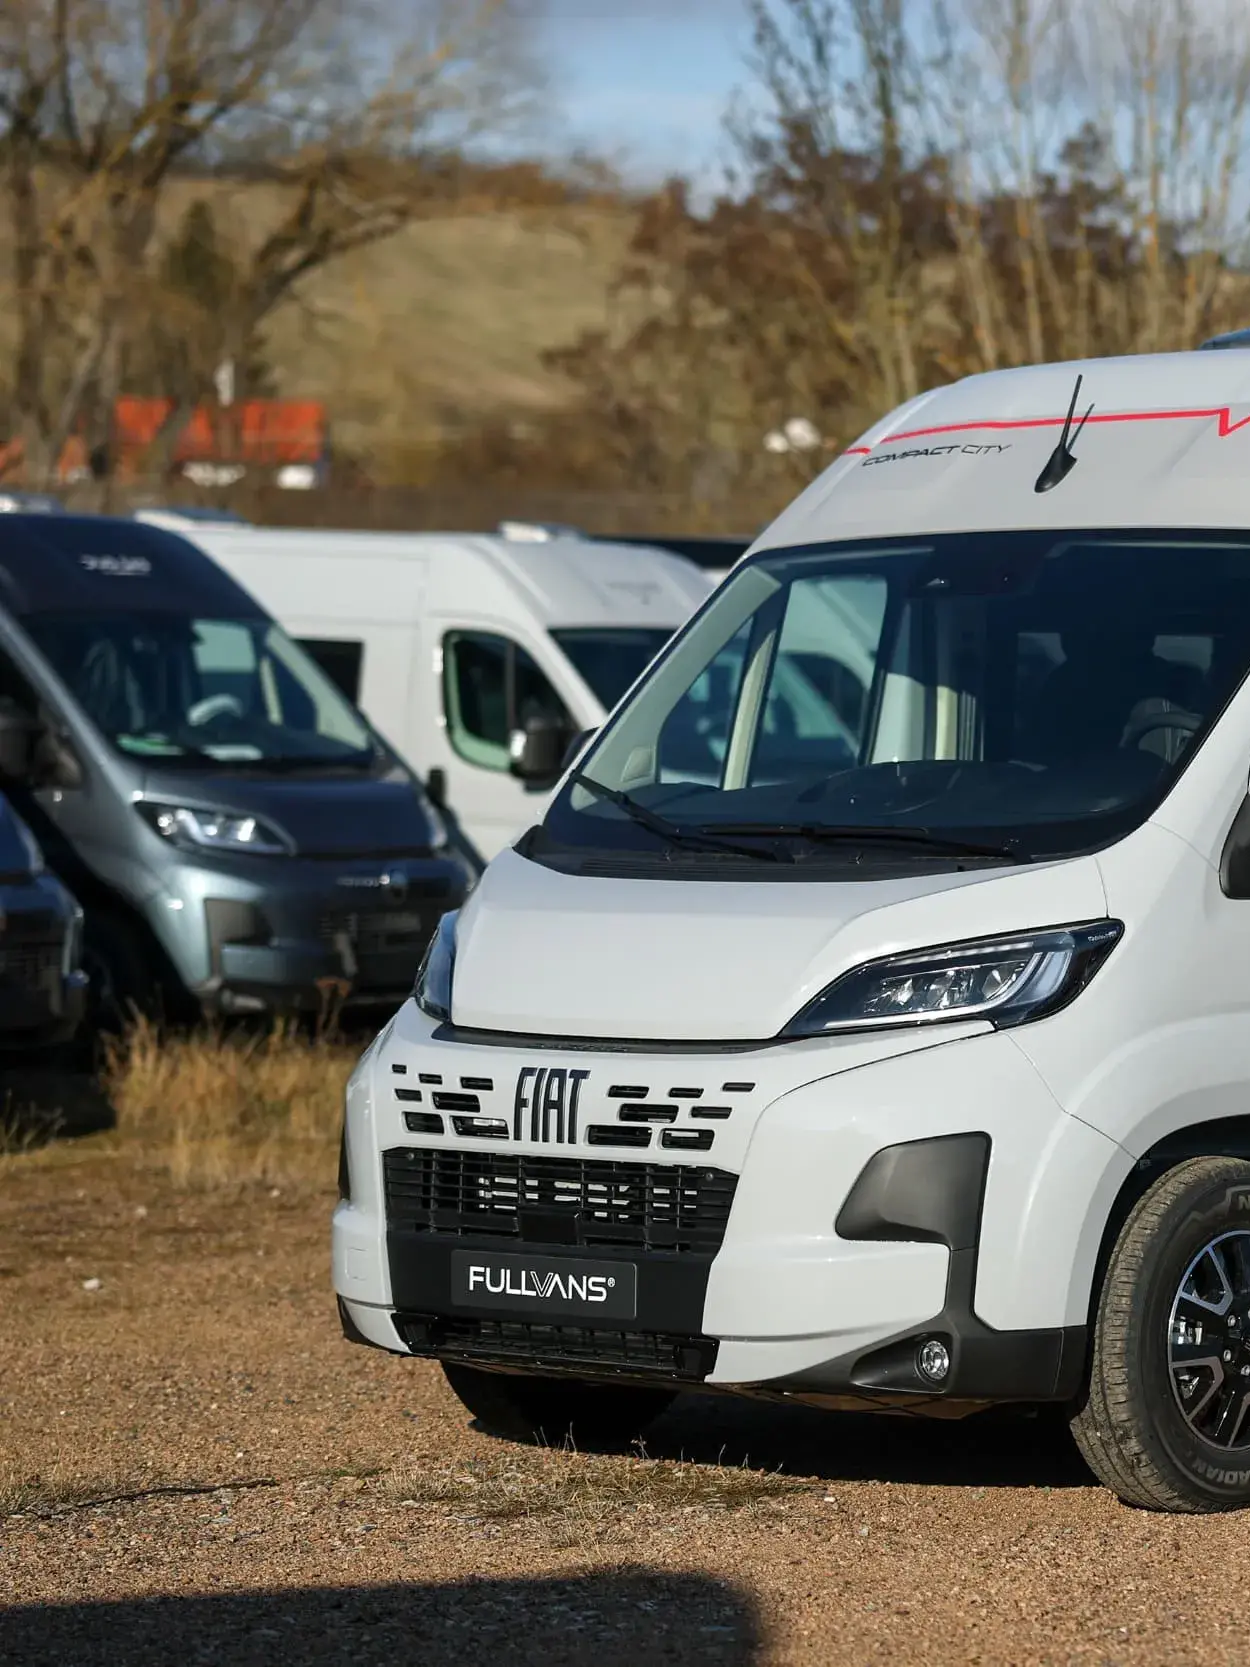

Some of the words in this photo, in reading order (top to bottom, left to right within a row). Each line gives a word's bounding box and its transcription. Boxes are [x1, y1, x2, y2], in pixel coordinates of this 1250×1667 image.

[862, 445, 960, 467] COMPACT
[961, 444, 1012, 455] CITY
[513, 1067, 591, 1144] FIAT
